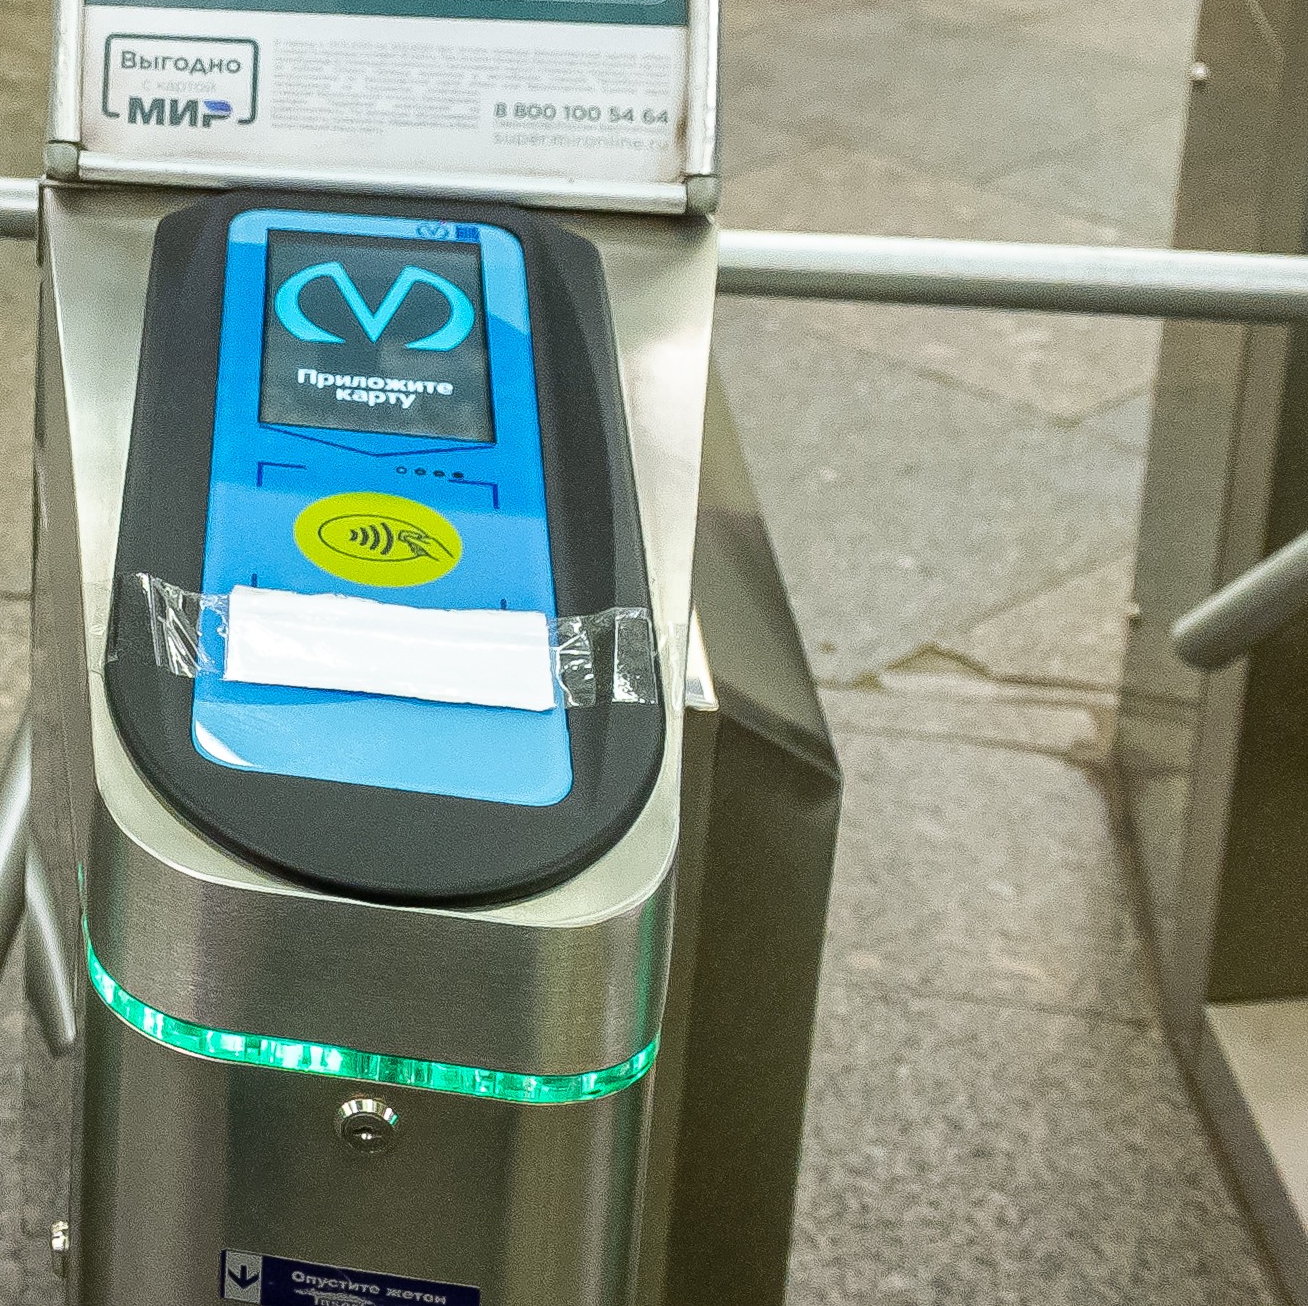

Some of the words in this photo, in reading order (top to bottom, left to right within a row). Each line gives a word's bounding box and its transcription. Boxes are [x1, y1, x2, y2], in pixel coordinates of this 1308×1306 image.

[121, 50, 241, 75] Выгодно
[127, 95, 234, 128] МИР
[494, 102, 508, 118] 8
[513, 102, 557, 120] 800
[563, 104, 602, 122] 100
[608, 106, 635, 123] 54
[641, 107, 670, 124] 64
[297, 368, 454, 396] Приложите
[335, 388, 417, 410] карту
[290, 1270, 381, 1296] Опустите
[385, 1286, 448, 1305] жетон
